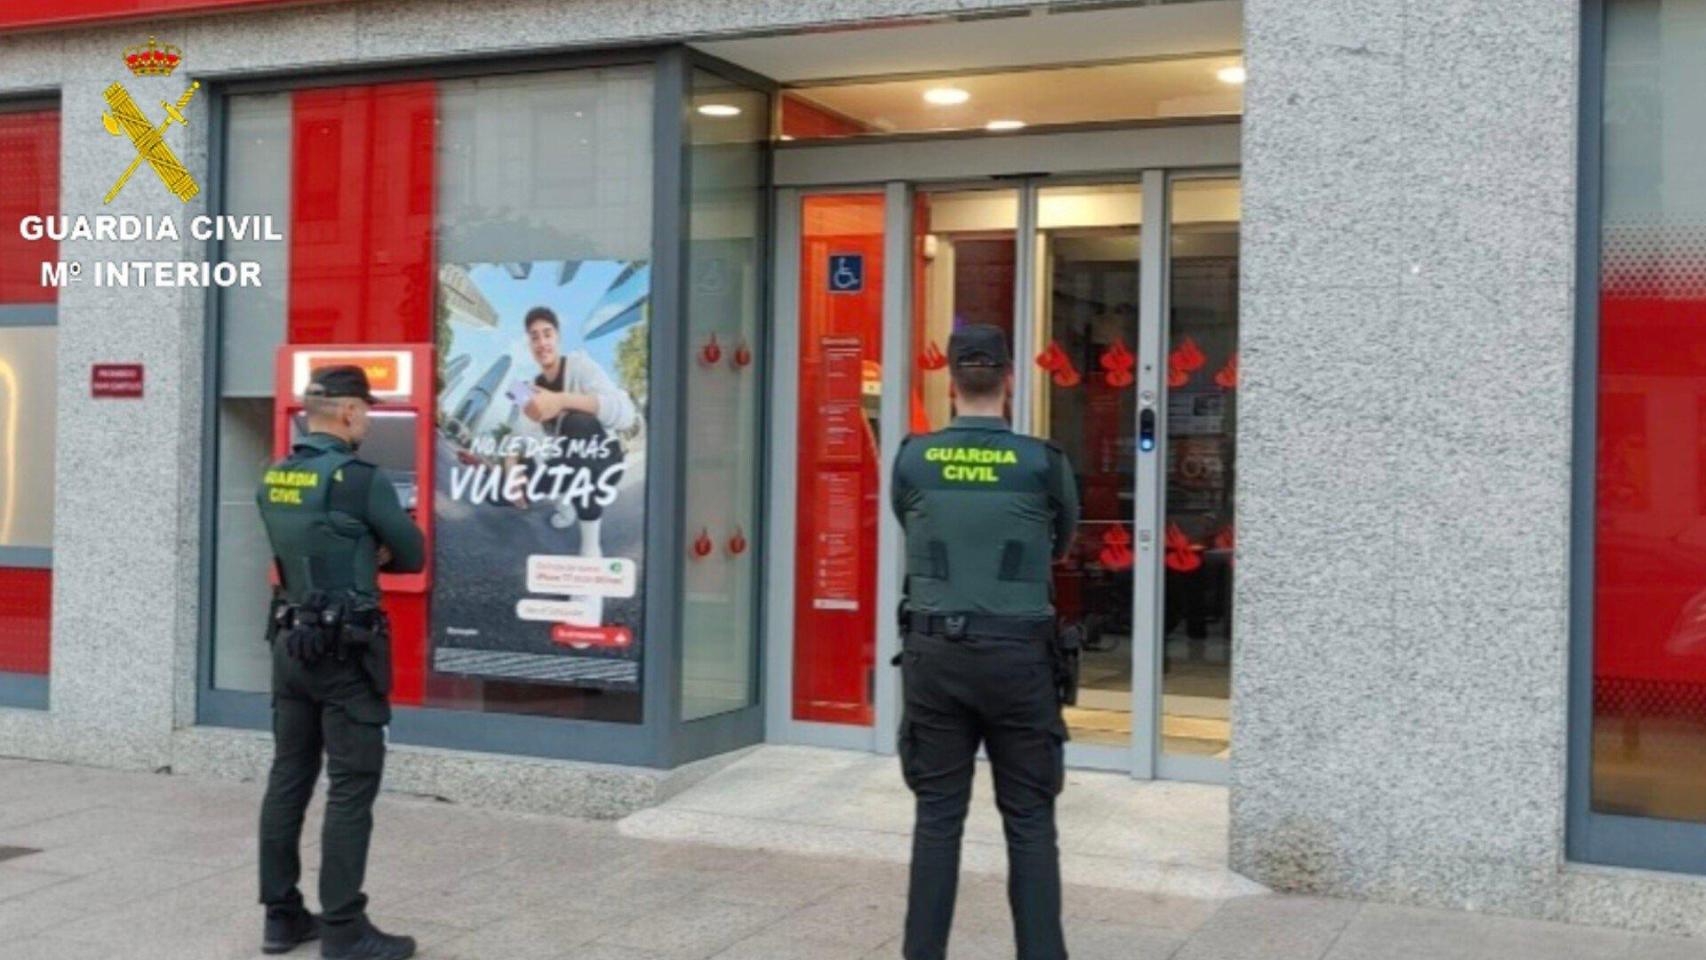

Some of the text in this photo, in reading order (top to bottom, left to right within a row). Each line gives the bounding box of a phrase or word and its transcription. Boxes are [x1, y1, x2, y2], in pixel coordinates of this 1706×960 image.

[470, 434, 619, 459] NO LE DES MÁS
[925, 448, 1017, 463] GUARDIA
[264, 471, 318, 488] GUARDIA
[943, 465, 999, 482] CIVIL
[450, 461, 628, 508] VUELTAS
[270, 487, 302, 504] CIVIL
